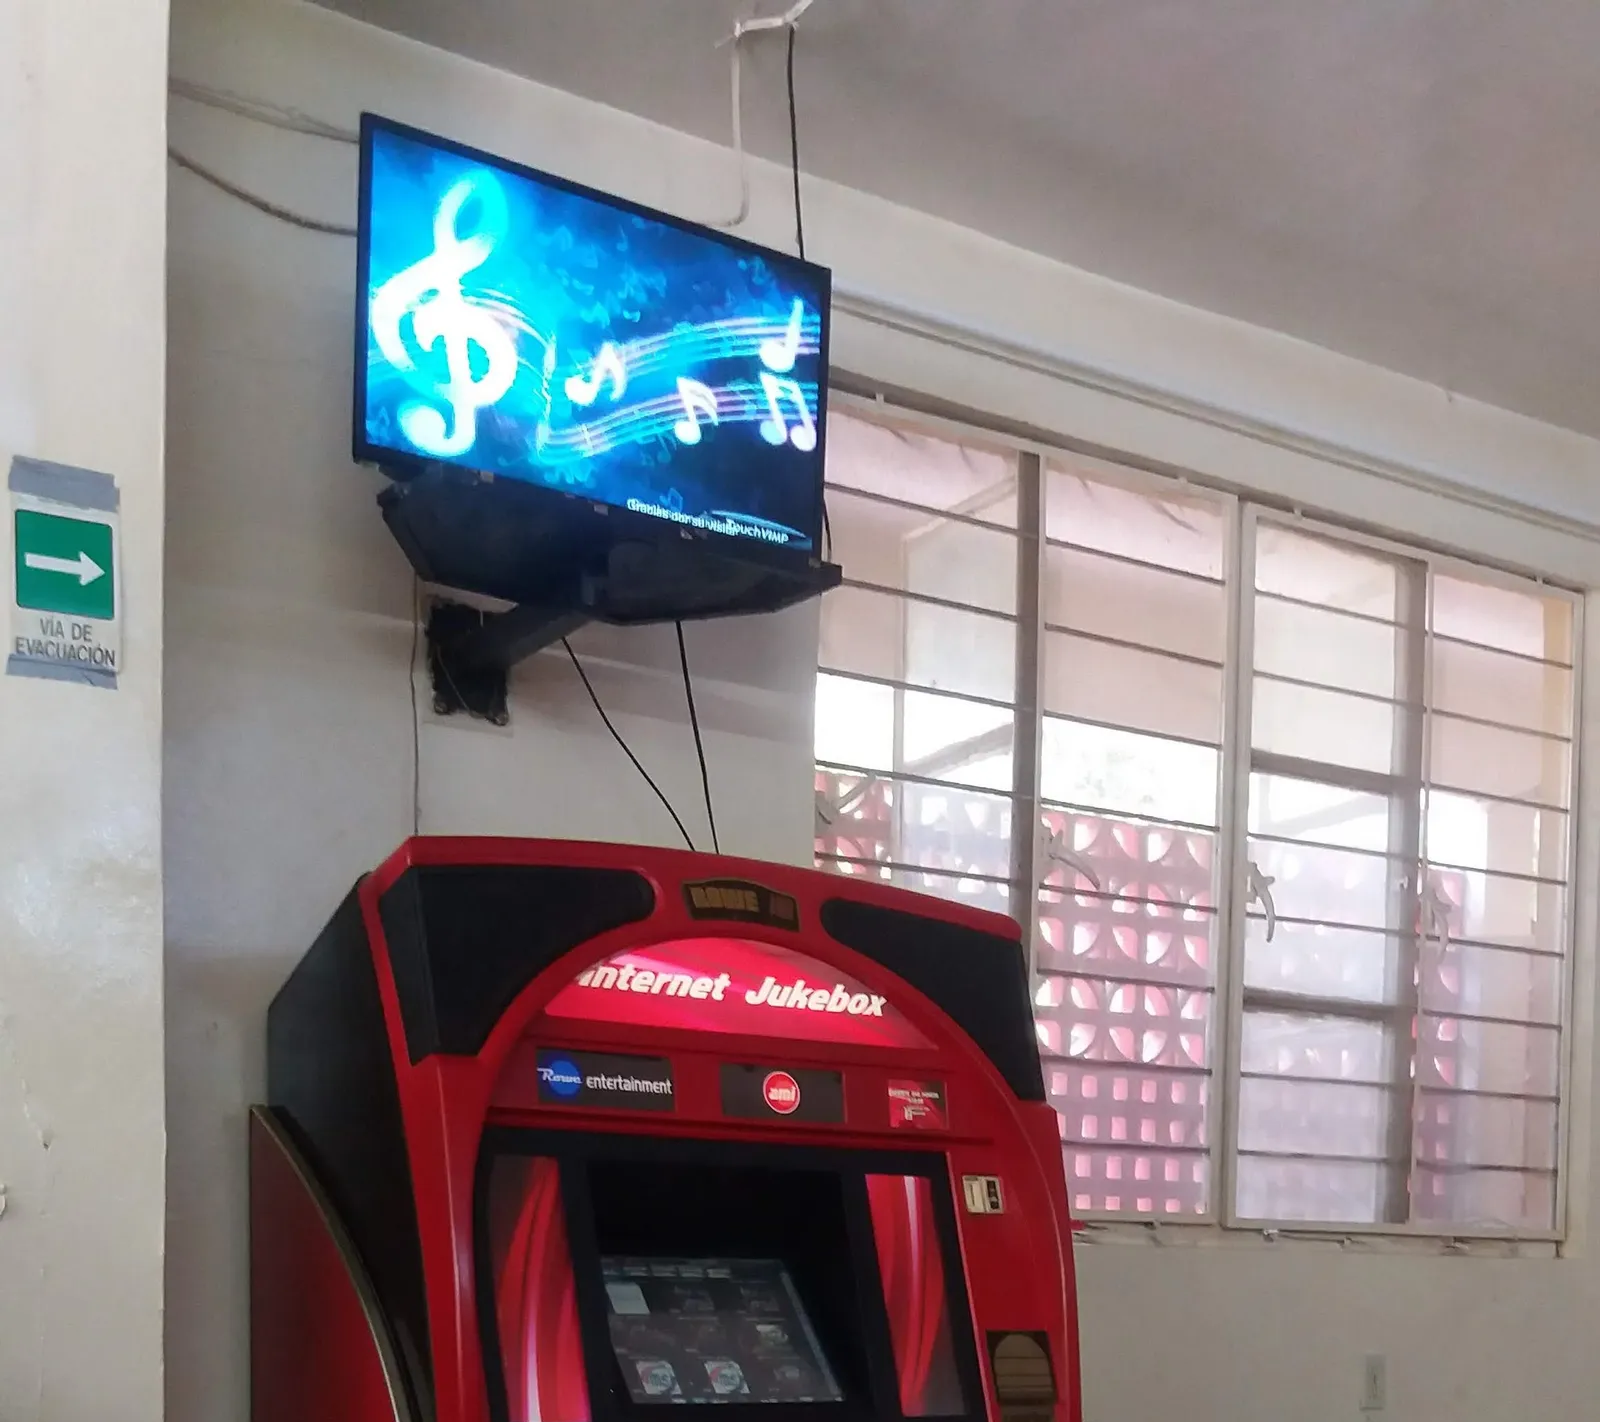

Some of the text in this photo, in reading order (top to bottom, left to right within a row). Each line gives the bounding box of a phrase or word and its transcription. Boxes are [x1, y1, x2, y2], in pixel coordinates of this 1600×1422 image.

[71, 622, 93, 643] DE
[15, 635, 116, 666] EVACUACIÓN
[745, 976, 888, 1017] Jukebox
[586, 1073, 673, 1095] entertainment
